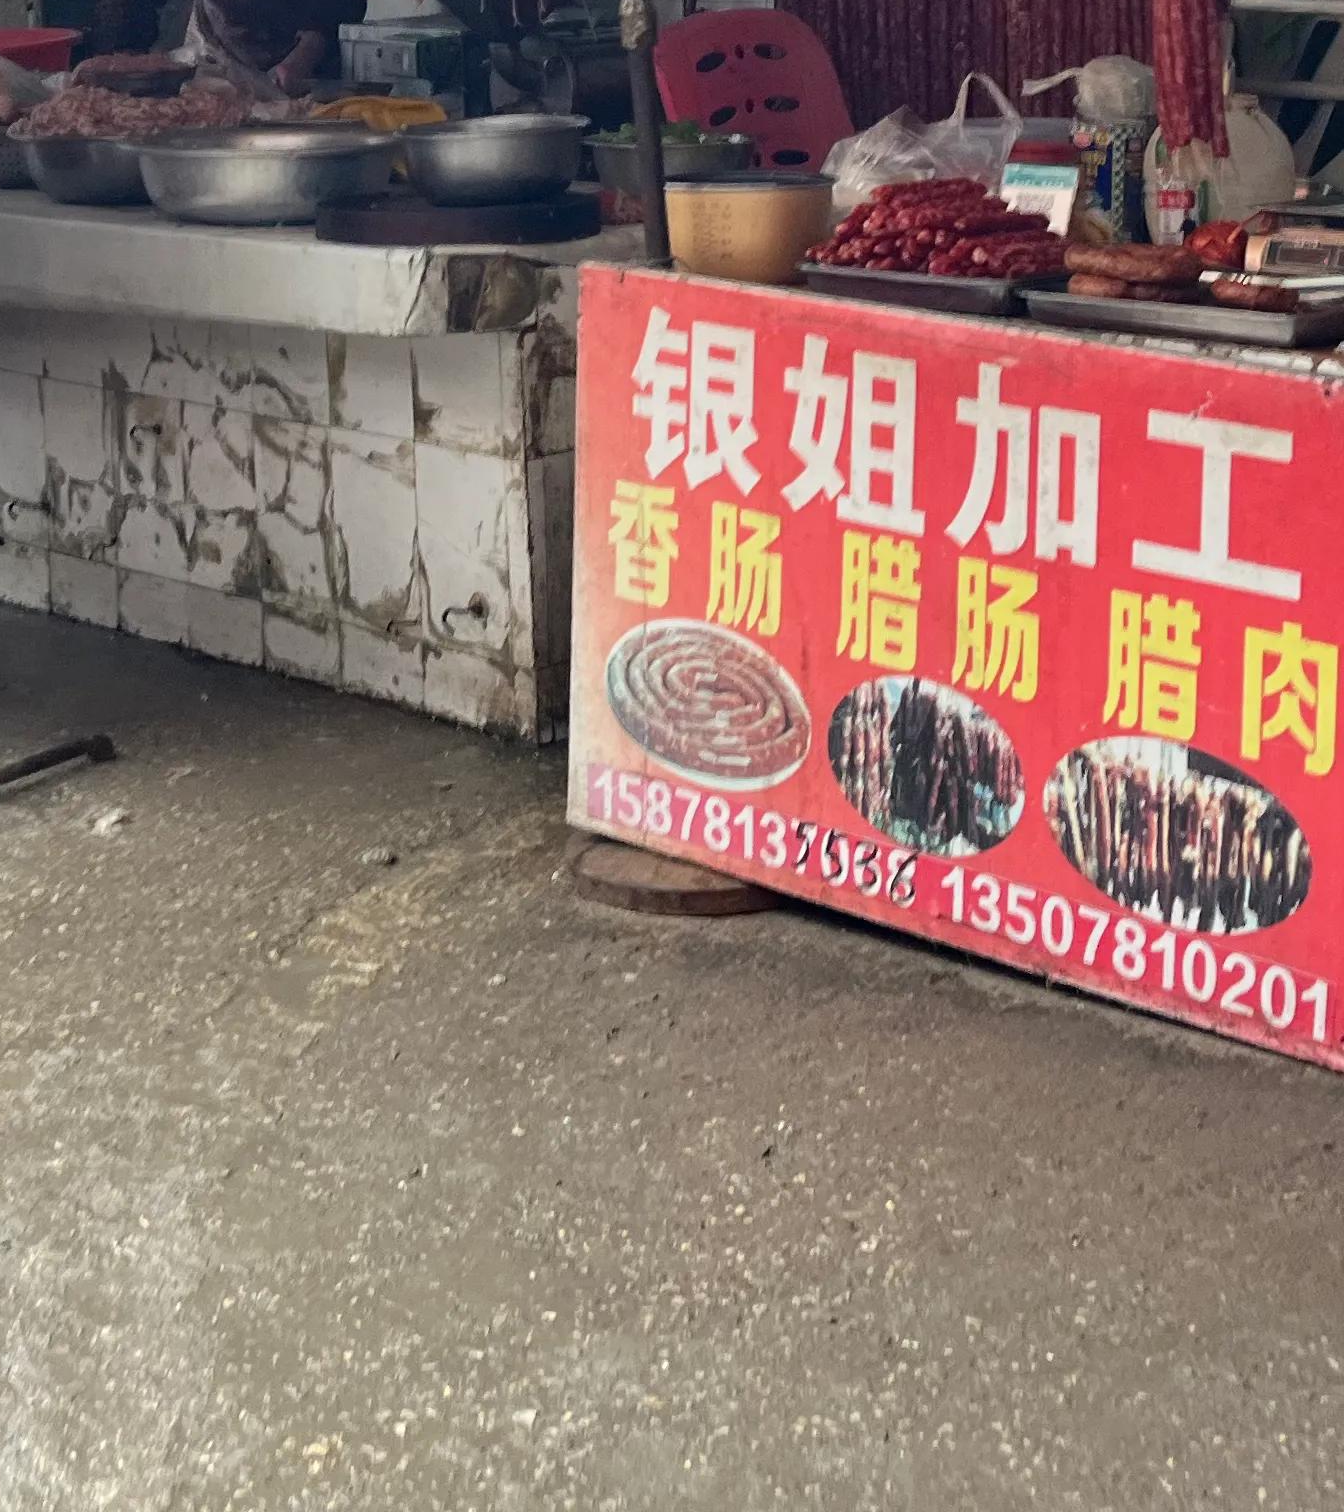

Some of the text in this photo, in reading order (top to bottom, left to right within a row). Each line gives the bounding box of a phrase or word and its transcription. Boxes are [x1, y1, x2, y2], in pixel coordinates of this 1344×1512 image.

[631, 305, 1303, 601] 银姐加工
[608, 479, 1339, 776] 香肠 腊肠 腊肉
[941, 865, 1330, 1042] 13507810201
